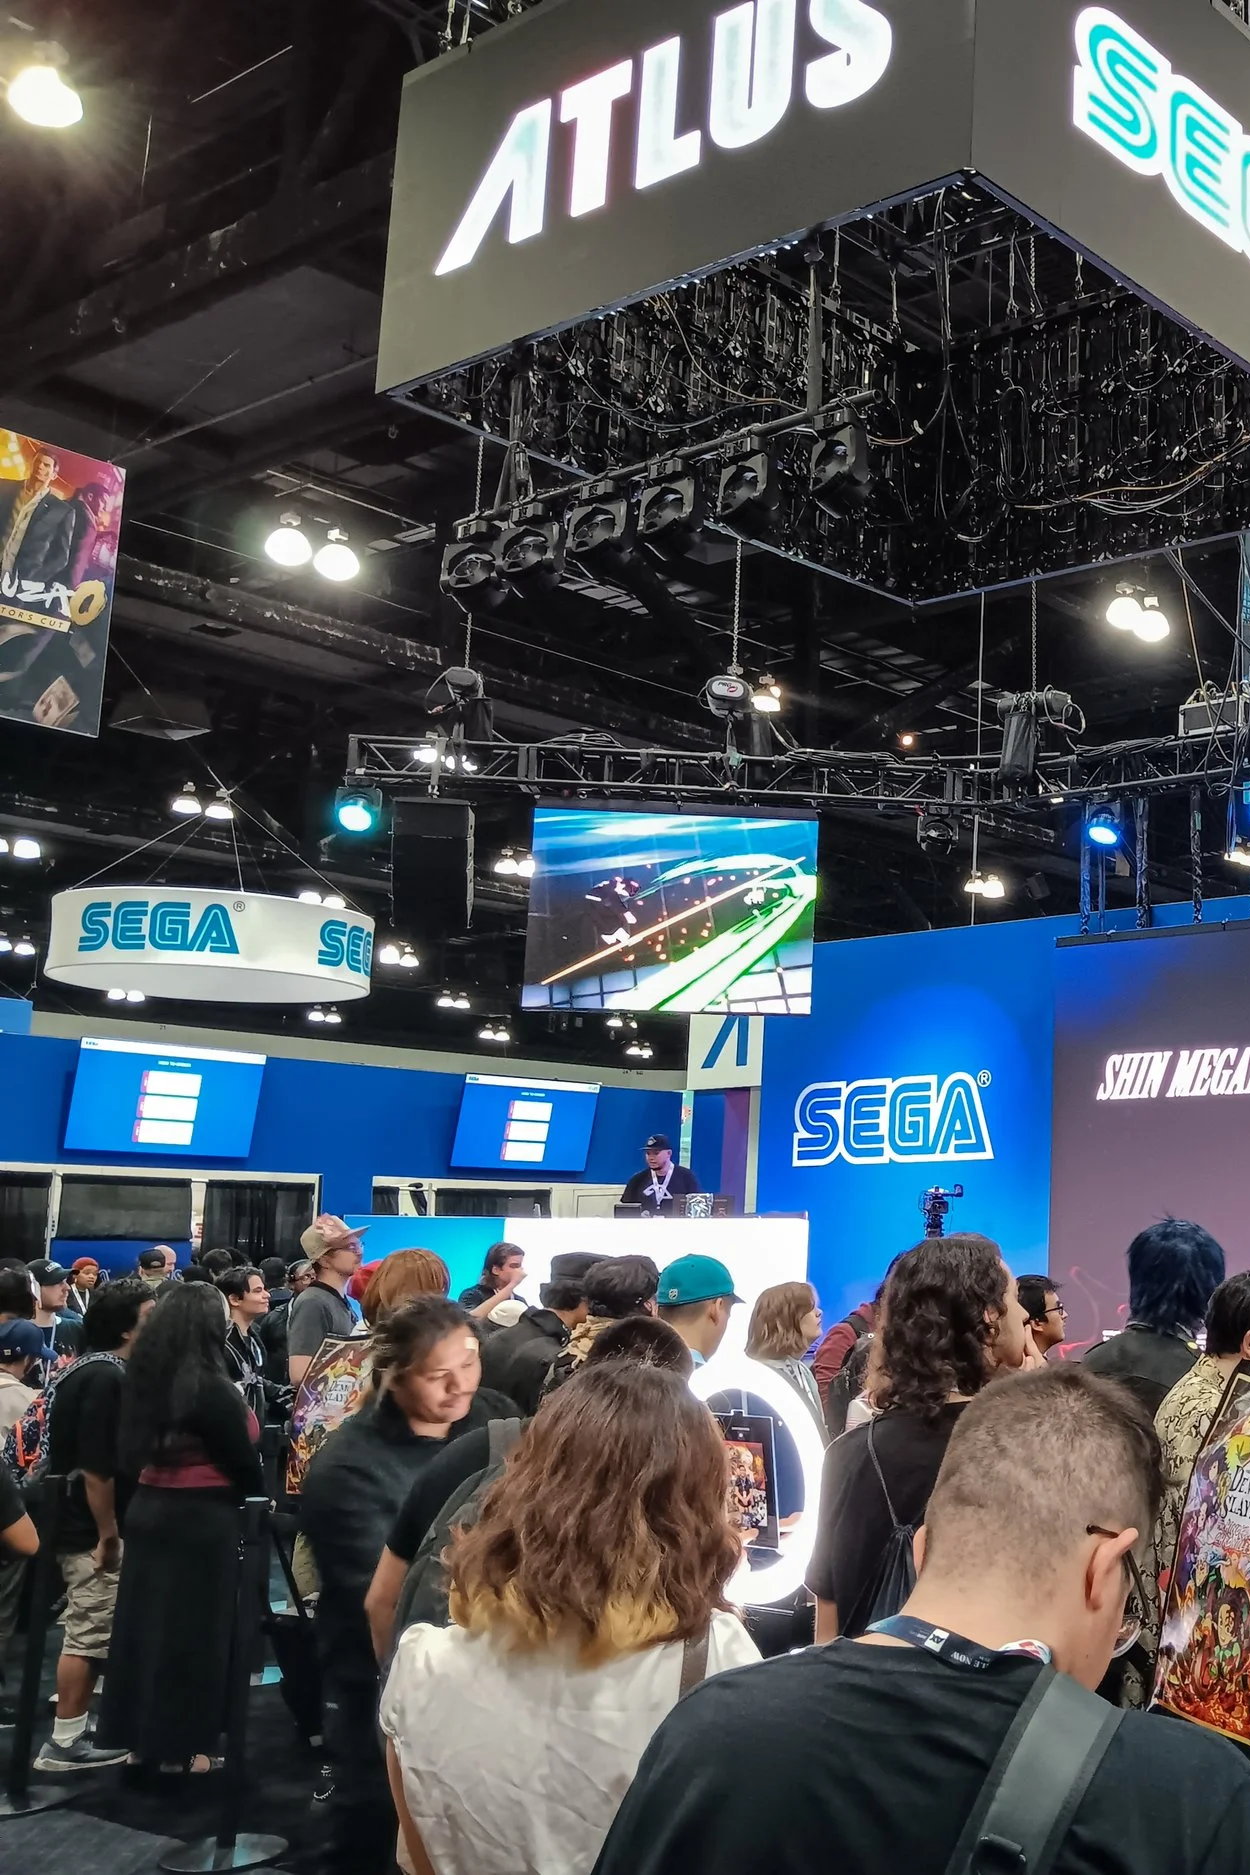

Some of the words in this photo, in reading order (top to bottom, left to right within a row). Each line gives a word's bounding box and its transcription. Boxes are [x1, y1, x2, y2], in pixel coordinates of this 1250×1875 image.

[434, 0, 893, 276] ATLUS
[40, 616, 64, 629] CUT
[1096, 1050, 1173, 1101] SHIN
